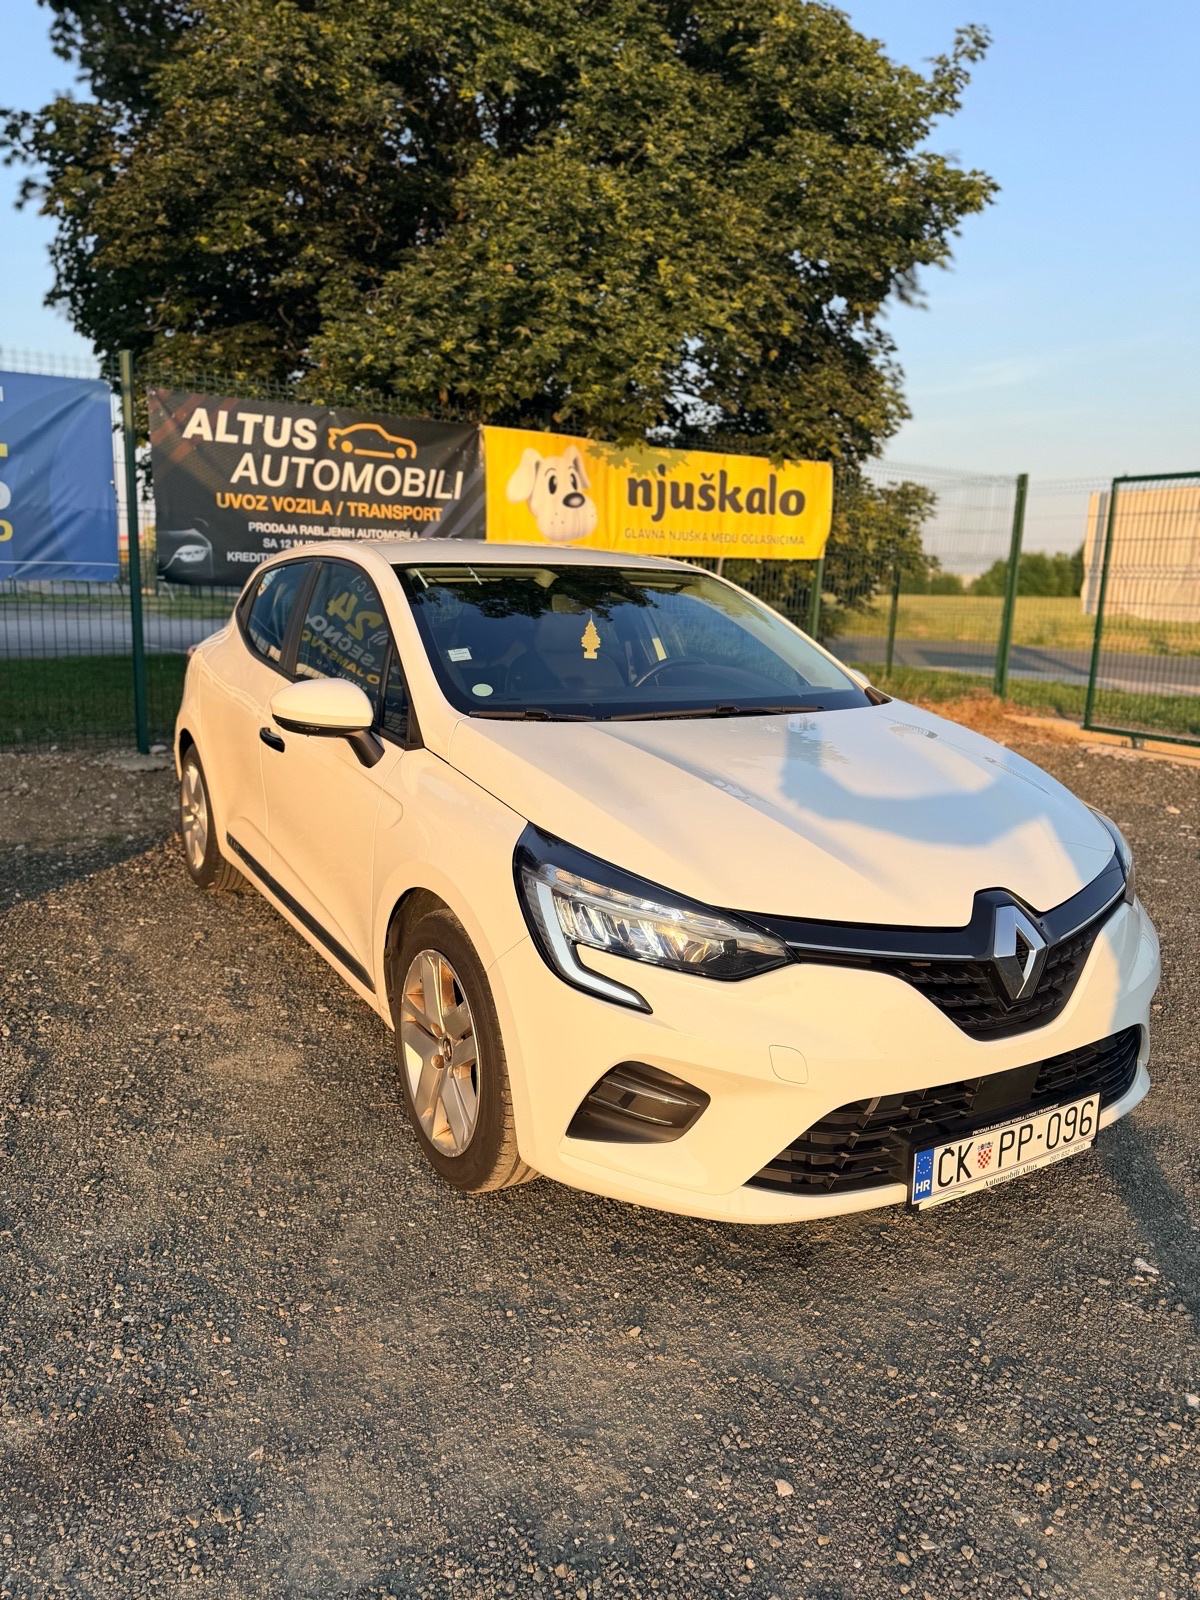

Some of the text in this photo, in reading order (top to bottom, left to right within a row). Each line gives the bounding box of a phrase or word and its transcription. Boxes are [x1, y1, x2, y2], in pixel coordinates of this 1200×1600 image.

[181, 407, 318, 452] ALTUS
[229, 452, 464, 501] AUTOMOBILI
[215, 492, 268, 512] UVOZ
[271, 496, 333, 516] VOZILA
[347, 501, 443, 522] TRANSPORT
[626, 463, 806, 523] njuškalo
[248, 521, 299, 535] PRODAJA
[299, 525, 356, 539] RABLJENIH
[263, 538, 278, 549] SA
[280, 539, 291, 549] 12
[624, 527, 666, 540] GLAVNA
[669, 529, 707, 542] NJUŠKA
[915, 1099, 1095, 1195] HR ČK PP-096
[983, 1169, 1020, 1188] Automobili
[1022, 1163, 1038, 1176] Altus
